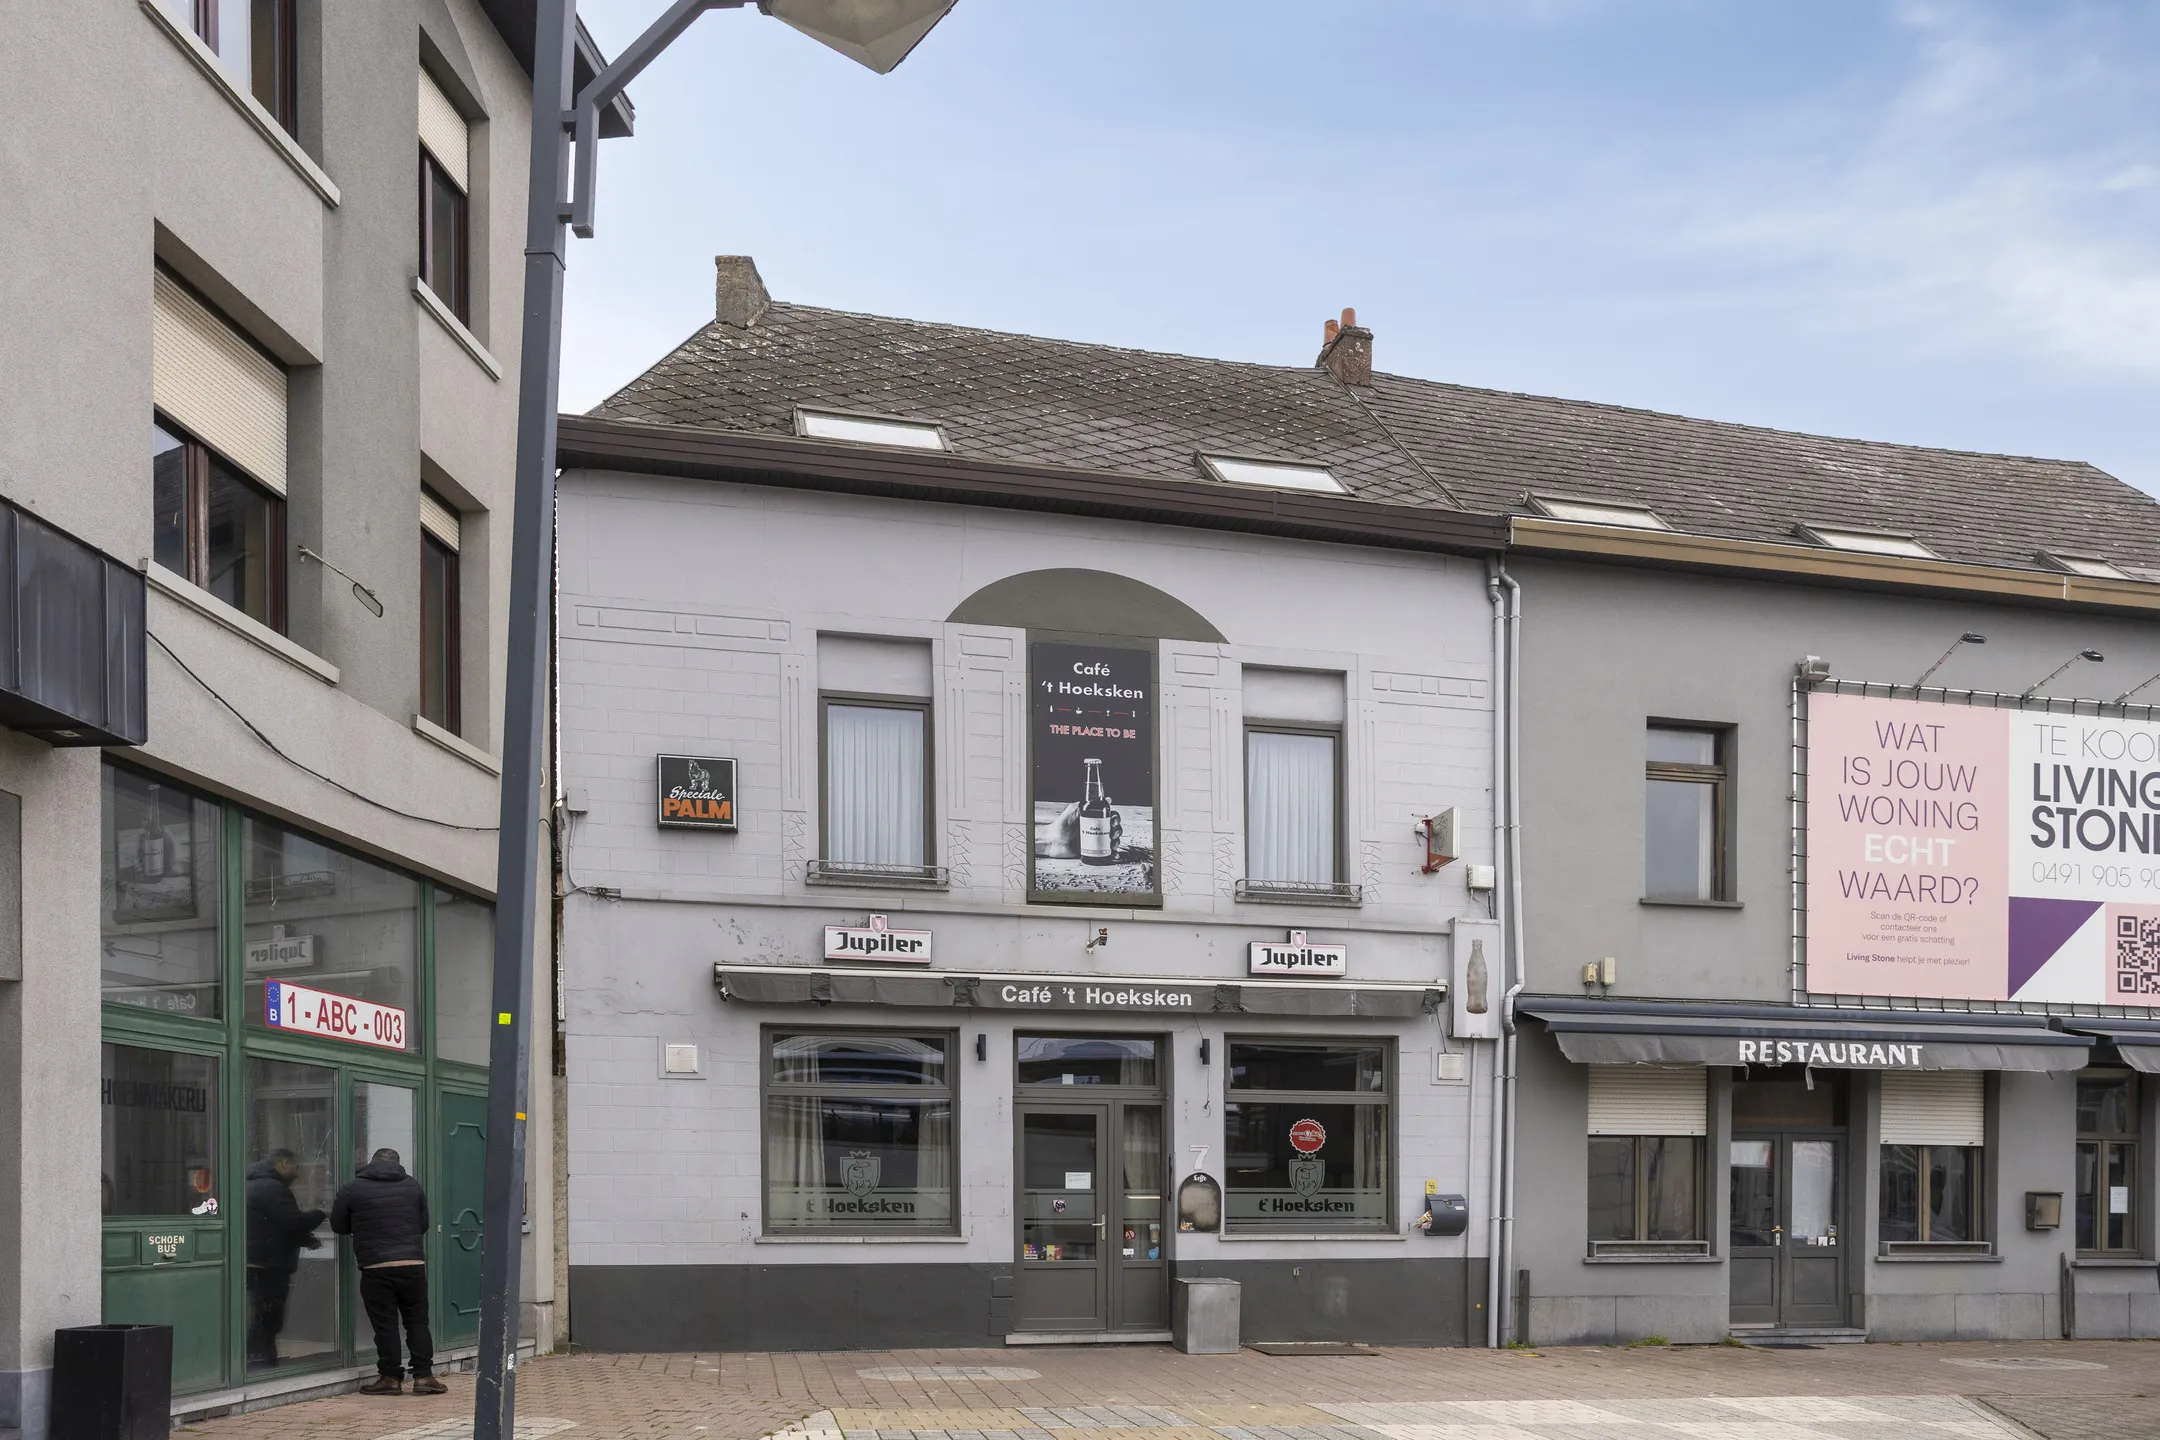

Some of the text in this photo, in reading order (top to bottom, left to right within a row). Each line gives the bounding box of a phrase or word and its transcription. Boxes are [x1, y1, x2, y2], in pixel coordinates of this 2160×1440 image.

[1073, 662, 1111, 676] Café
[1059, 682, 1143, 699] Hoeksken
[1049, 724, 1136, 738] THE PLACE TO BE
[1875, 720, 1946, 753] WAT
[2033, 723, 2160, 763] TE KOO
[1843, 756, 1977, 793] IS JOUW
[669, 786, 725, 800] Speciale
[663, 798, 731, 819] PALM
[1838, 793, 1979, 830] WONING
[1864, 833, 1956, 867] ECHT
[2032, 861, 2081, 884] 0491
[2092, 864, 2132, 888] 905
[1838, 870, 1979, 905] WAARD?
[1870, 911, 1947, 923] Scan de QR-code of
[1880, 923, 1921, 932] contacteer
[834, 932, 922, 954] Jupiler
[1897, 934, 1918, 943] gratis
[1920, 936, 1955, 945] schatting
[1260, 948, 1338, 969] Jupiler
[1846, 953, 1970, 966] Living Stone helpt je met plezier!
[1001, 985, 1052, 1003] Café
[1086, 987, 1192, 1006] Hoeksken
[270, 1008, 278, 1021] B
[1739, 1040, 1923, 1065] RESTAURANT
[1189, 1144, 1211, 1171] 7
[1272, 1198, 1355, 1213] Hoeksken
[148, 1235, 185, 1245] SCHOEN
[157, 1244, 177, 1253] BUS
